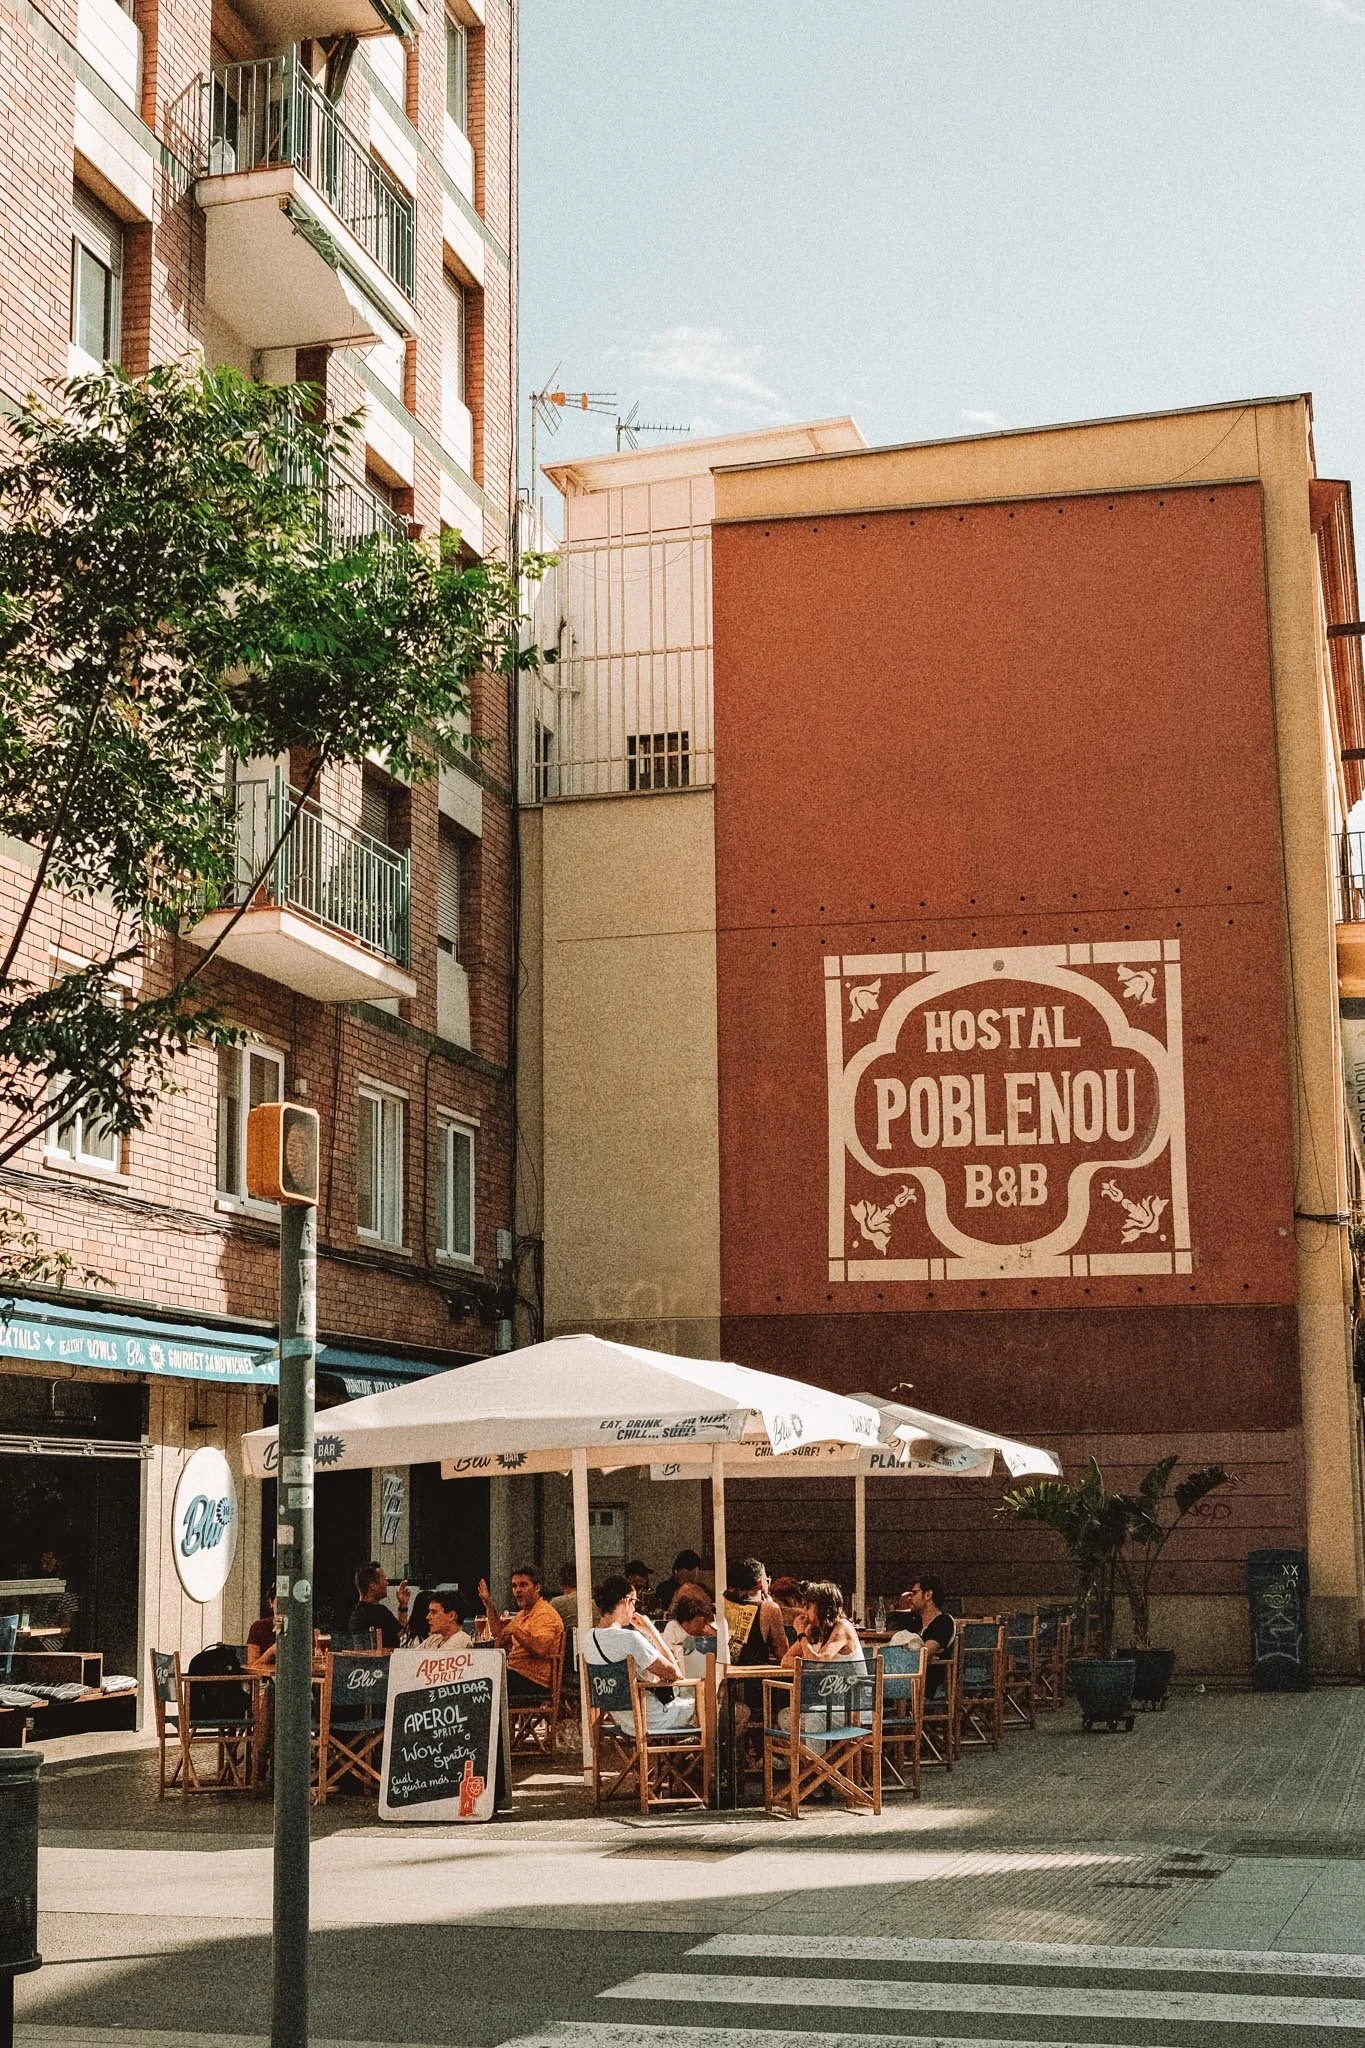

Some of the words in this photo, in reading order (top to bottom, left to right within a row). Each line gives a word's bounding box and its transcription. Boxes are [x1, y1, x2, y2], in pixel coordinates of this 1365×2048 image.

[924, 1006, 1081, 1053] HOSTAL
[874, 1069, 1136, 1150] POBLENOU
[964, 1163, 1048, 1208] B&B
[168, 1349, 204, 1371] GOURMET
[600, 1420, 622, 1429] EAT,
[617, 1430, 659, 1440] CHILL...
[318, 1444, 335, 1457] BAR
[792, 1446, 820, 1457] SURF!
[181, 1495, 224, 1557] Blu
[416, 1654, 474, 1678] APEROL
[346, 1669, 377, 1690] Blu
[425, 1669, 464, 1686] SPRITZ
[593, 1676, 614, 1696] Blu
[818, 1674, 851, 1696] Blu
[404, 1704, 468, 1735] APEROL
[432, 1724, 464, 1739] SPRITZ
[434, 1745, 477, 1770] Spritz
[391, 1772, 413, 1785] Cuál
[391, 1785, 401, 1795] te
[402, 1779, 427, 1798] gusta
